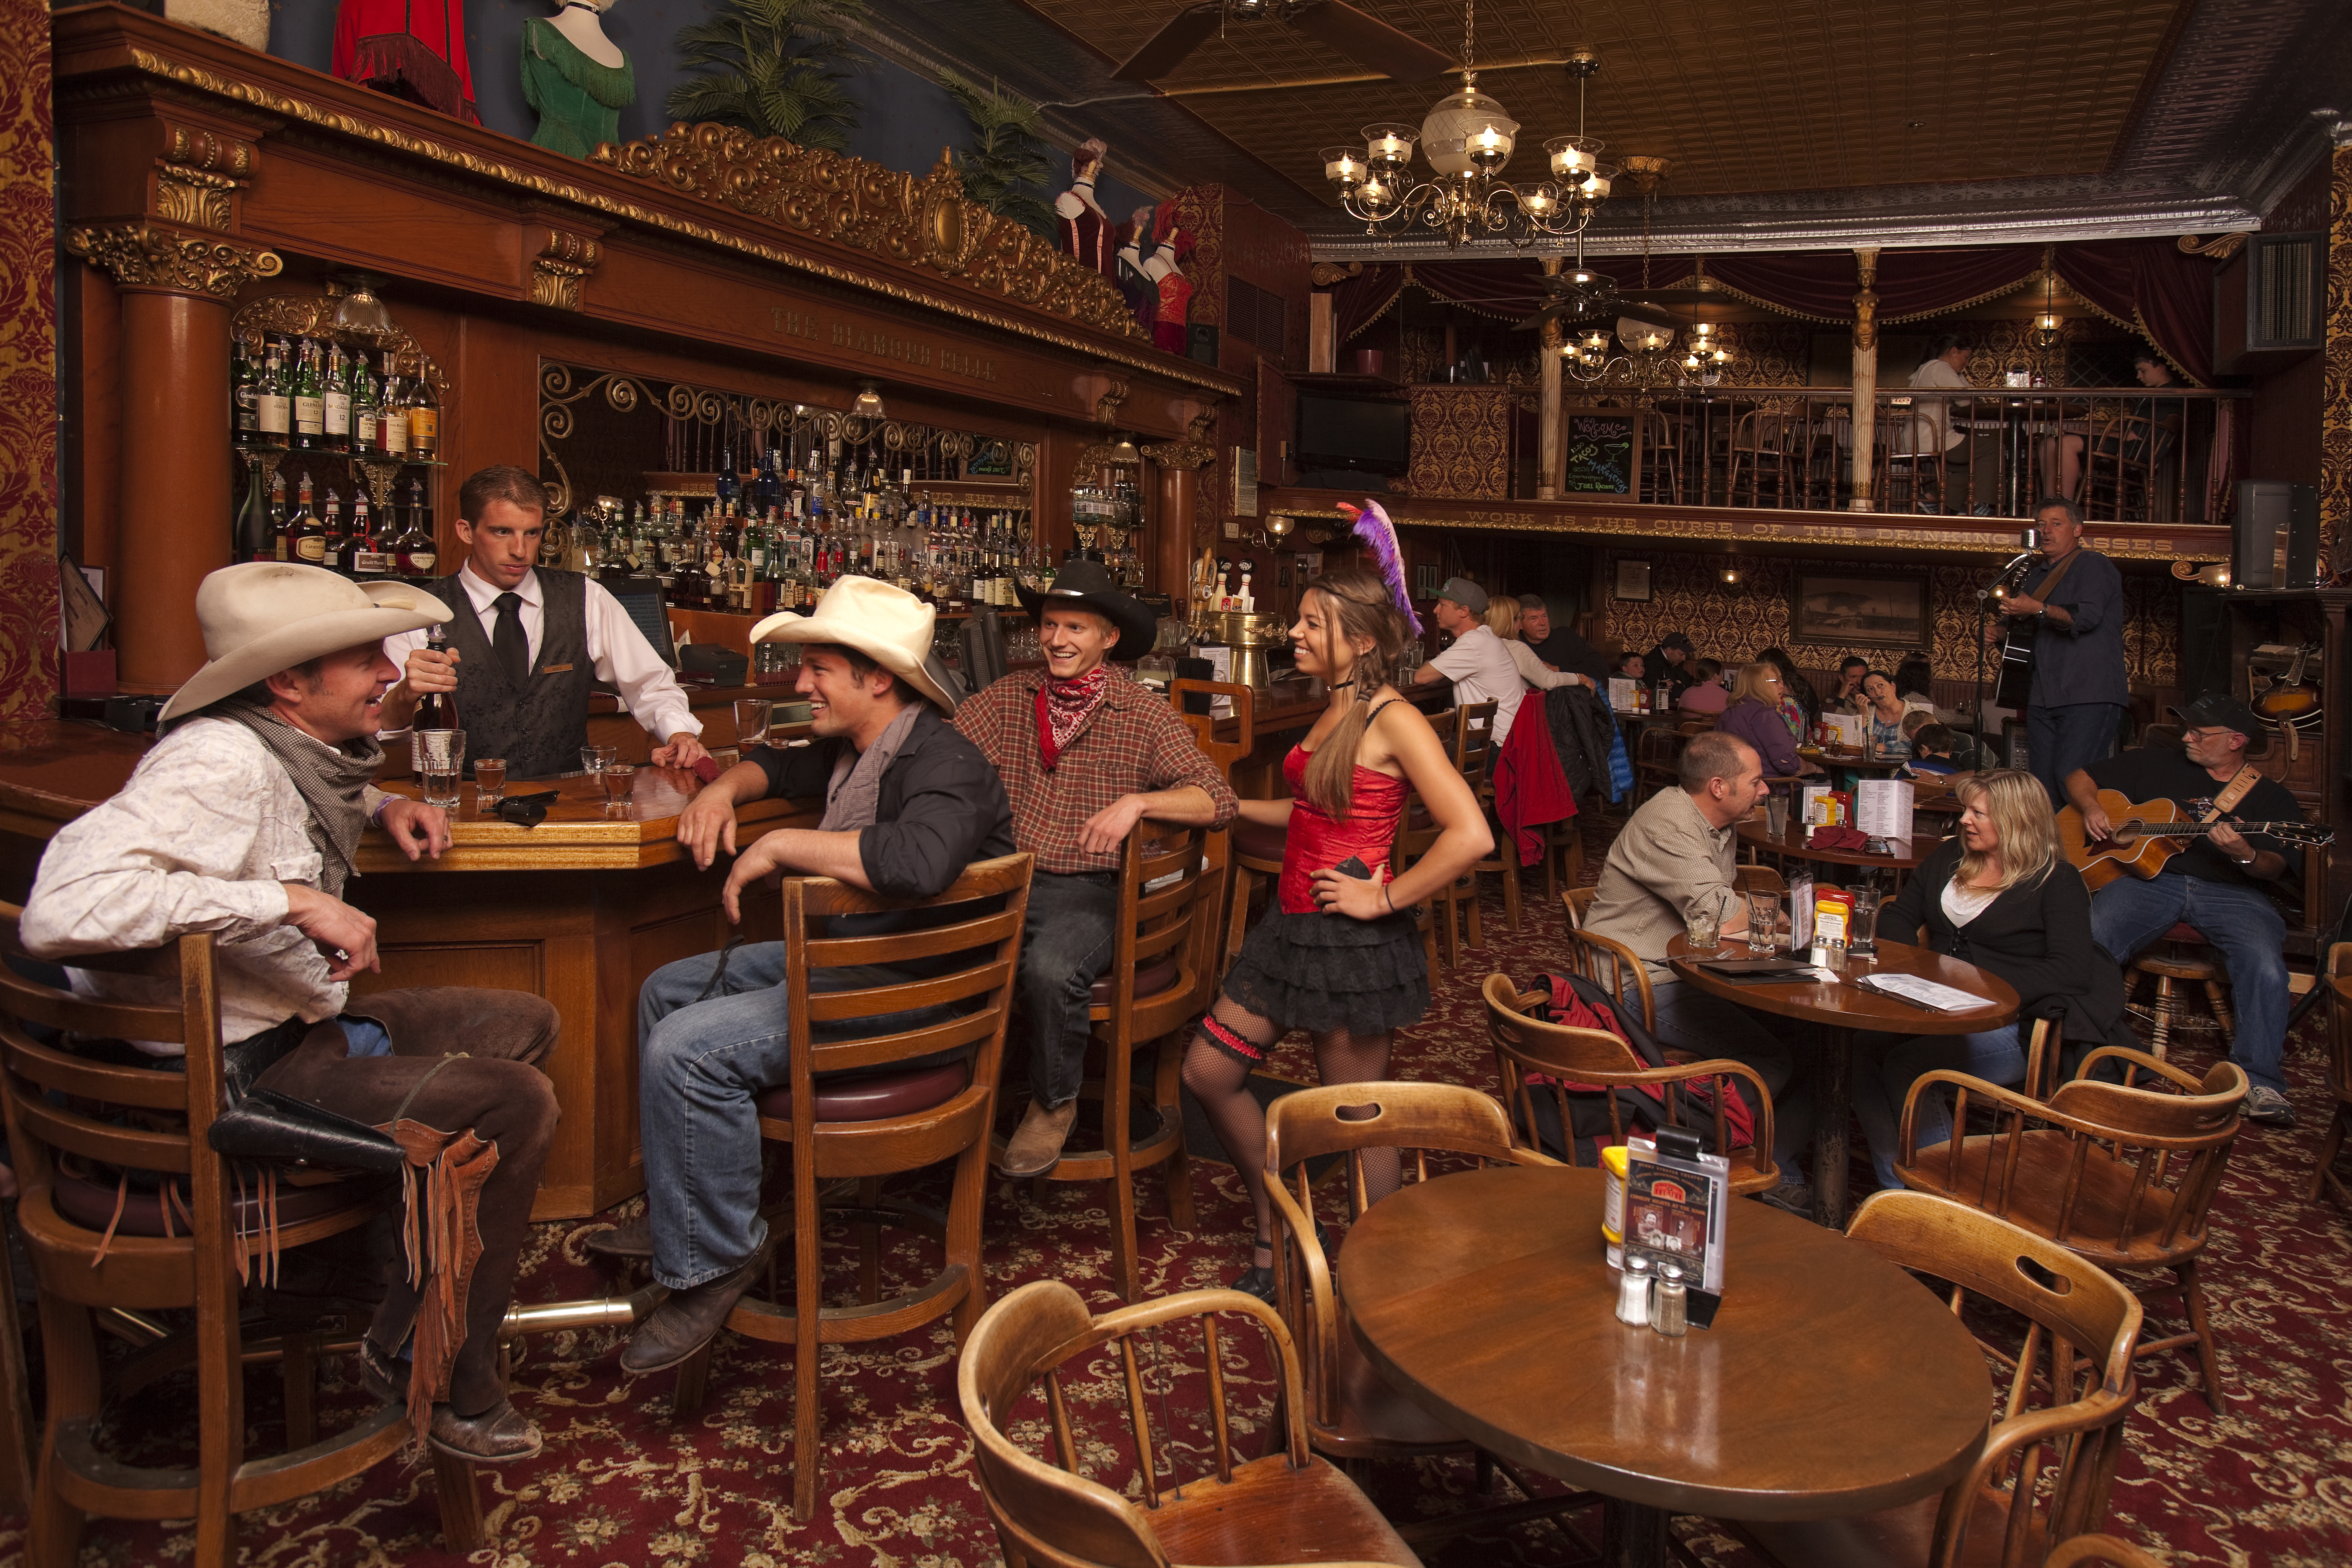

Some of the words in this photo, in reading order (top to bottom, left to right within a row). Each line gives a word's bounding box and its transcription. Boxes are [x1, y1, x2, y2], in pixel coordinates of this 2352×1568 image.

[771, 306, 818, 341] THE
[832, 322, 931, 367] DIAMOND
[939, 348, 996, 382] BELLE
[1570, 444, 1599, 463] TACOS
[1466, 511, 1535, 523] WORK
[1555, 515, 1576, 525] IS
[1592, 517, 1637, 528] THE
[1654, 519, 1733, 532] CURSE
[1753, 524, 1784, 534] OF
[1803, 525, 1857, 537] THE
[1876, 529, 2011, 544] DRINKING
[2078, 537, 2172, 551] ASSES
